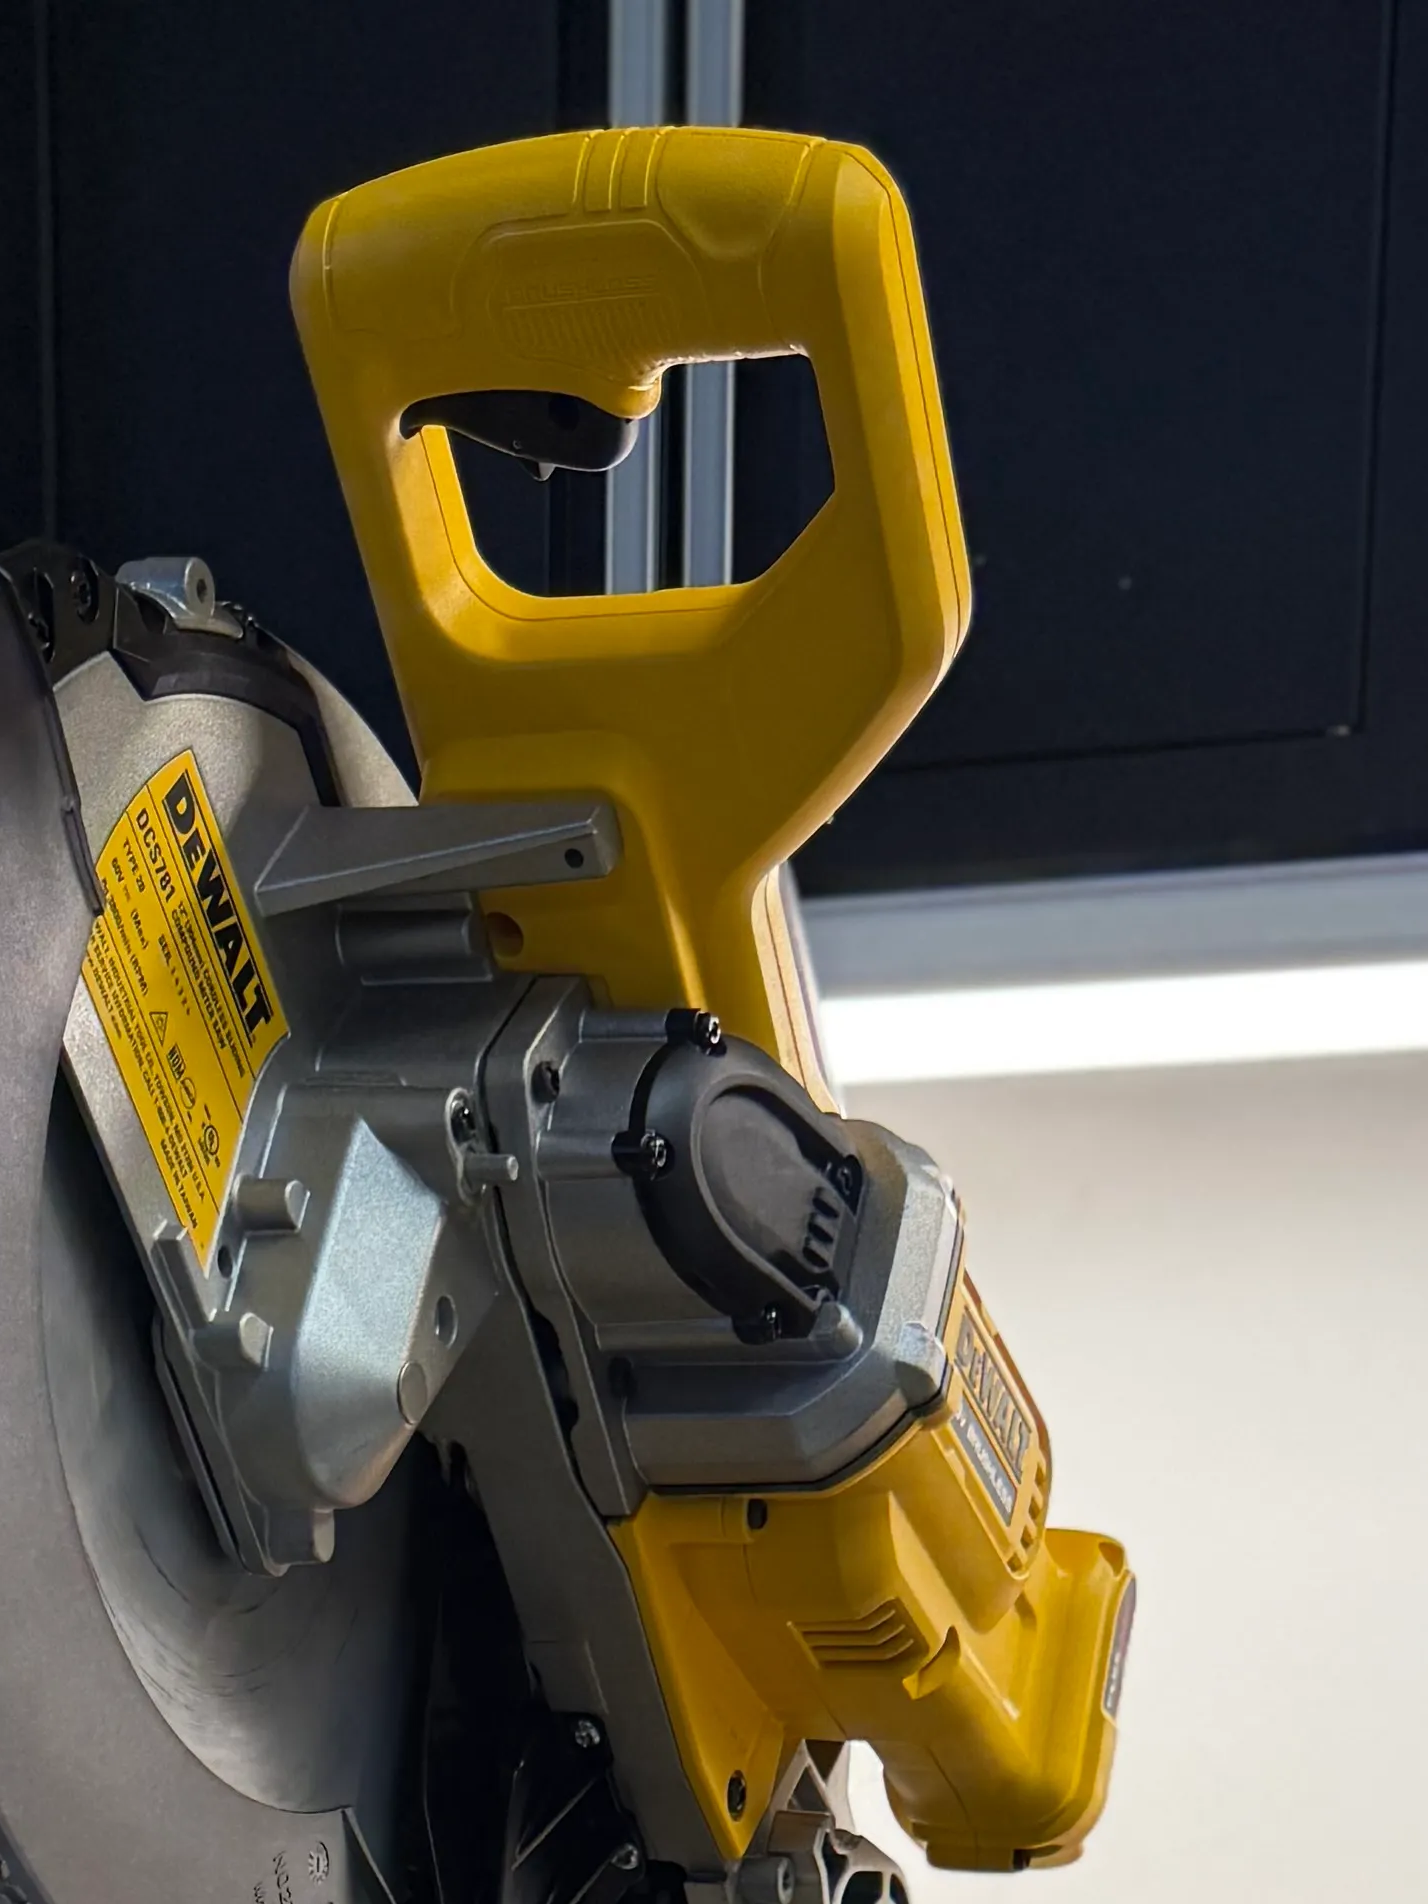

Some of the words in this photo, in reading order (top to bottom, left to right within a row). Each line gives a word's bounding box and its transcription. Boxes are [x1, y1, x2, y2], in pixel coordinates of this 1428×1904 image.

[110, 856, 124, 885] 60V
[121, 837, 139, 874] TYPE
[135, 806, 176, 902] DCS781
[163, 773, 273, 1043] DEWALT
[170, 907, 201, 981] COMPOUND
[197, 979, 215, 1020] MITER
[211, 1017, 226, 1052] SAW
[956, 1318, 1031, 1476] DEWALT
